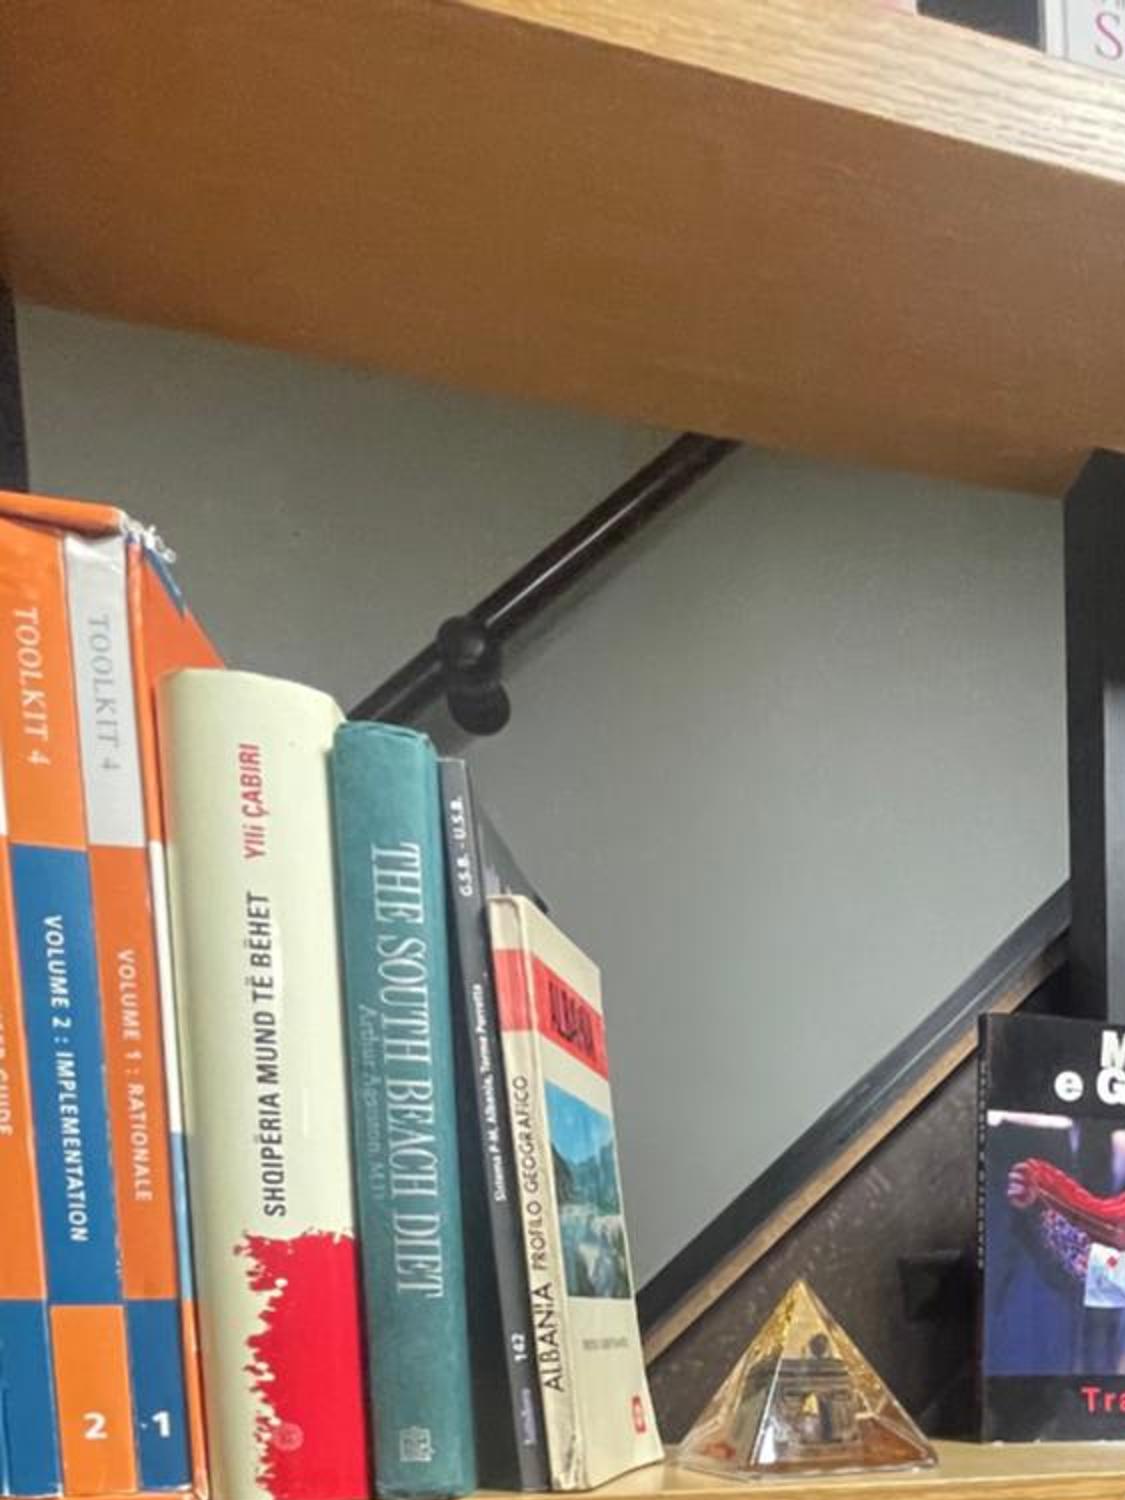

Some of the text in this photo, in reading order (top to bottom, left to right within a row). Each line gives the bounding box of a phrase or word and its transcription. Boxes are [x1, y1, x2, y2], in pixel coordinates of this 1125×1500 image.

[15, 607, 51, 766] TOOLKIT 4
[88, 615, 121, 773] TOOLKIT 4
[239, 743, 268, 821] ÇABIRI
[45, 914, 68, 1008] VOLUME
[116, 948, 140, 1043] VOLUME
[52, 1012, 70, 1029] 2
[244, 892, 287, 1217] SHQIPËRIA MUND TË BËHET
[372, 842, 443, 1299] THE SOUTH BEACH DIET
[1055, 1071, 1083, 1100] e
[55, 1051, 88, 1242] IMPLEMENTATION
[127, 1082, 153, 1203] RATIONALE
[512, 1075, 564, 1391] ALBANIA PROFILO GEOGRAFICO
[512, 1334, 526, 1361] 142
[83, 1413, 107, 1439] 2
[152, 1411, 171, 1437] 1
